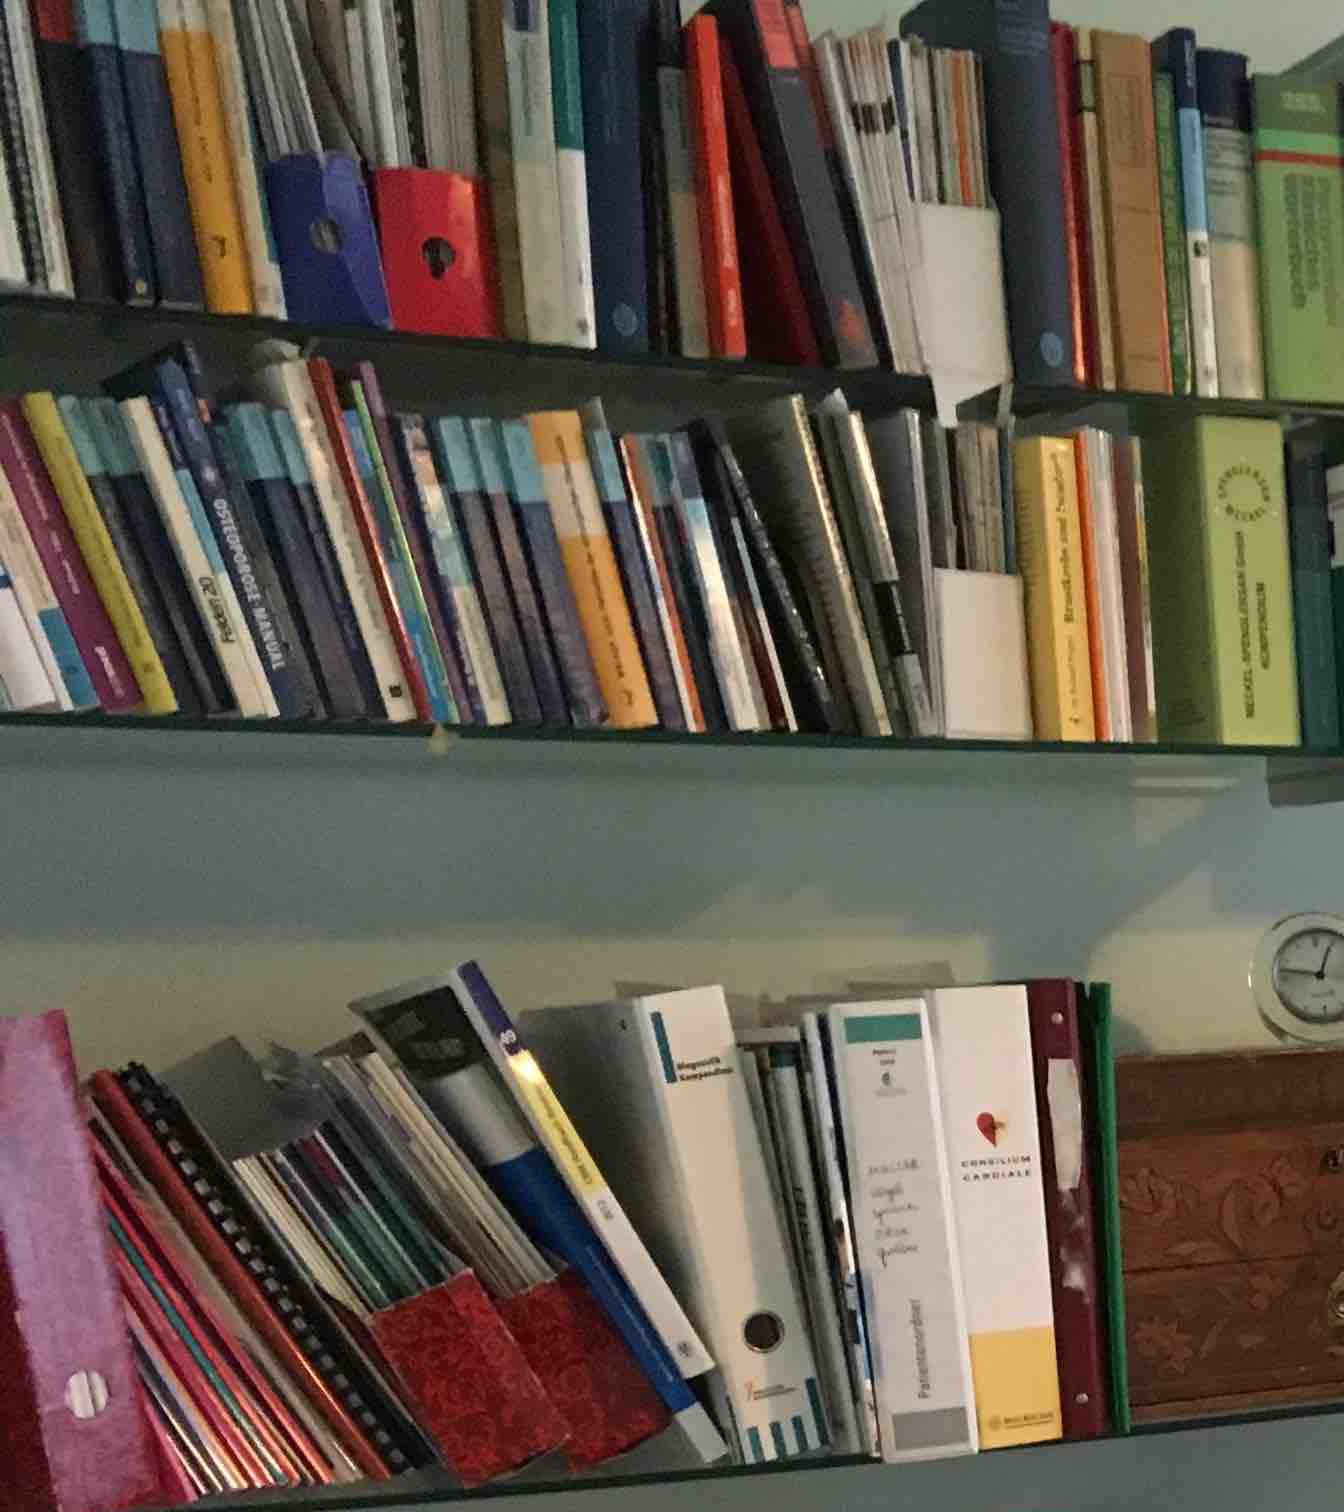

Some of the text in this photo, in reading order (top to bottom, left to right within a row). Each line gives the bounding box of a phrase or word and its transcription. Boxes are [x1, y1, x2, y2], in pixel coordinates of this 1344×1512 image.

[1255, 582, 1271, 668] KOMPENDIUM
[961, 1155, 1031, 1168] CONSILIUM
[962, 1169, 1032, 1182] CARDIALE
[918, 1298, 932, 1399] Patientenordner
